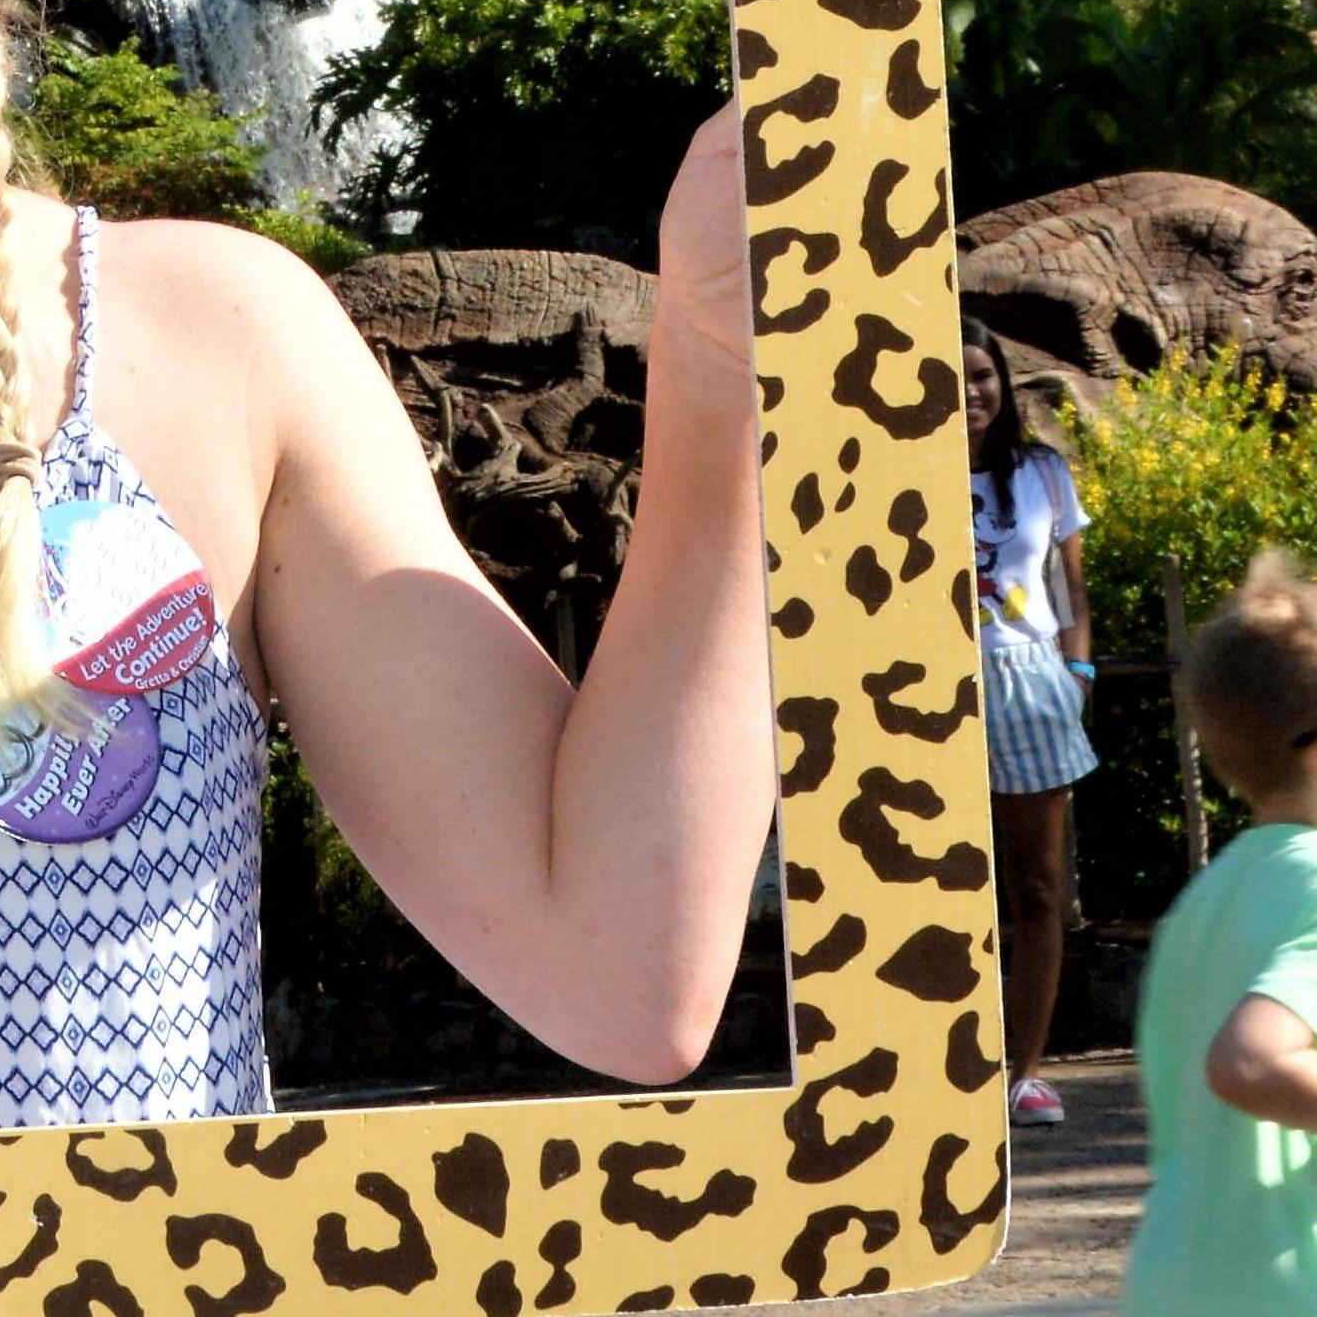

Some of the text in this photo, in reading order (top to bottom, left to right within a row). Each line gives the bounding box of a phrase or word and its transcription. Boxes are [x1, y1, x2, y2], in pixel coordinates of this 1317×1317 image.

[80, 583, 209, 681] Let the Adventure
[115, 607, 208, 684] Continue!
[14, 732, 82, 819] Happil
[61, 754, 98, 816] Ever
